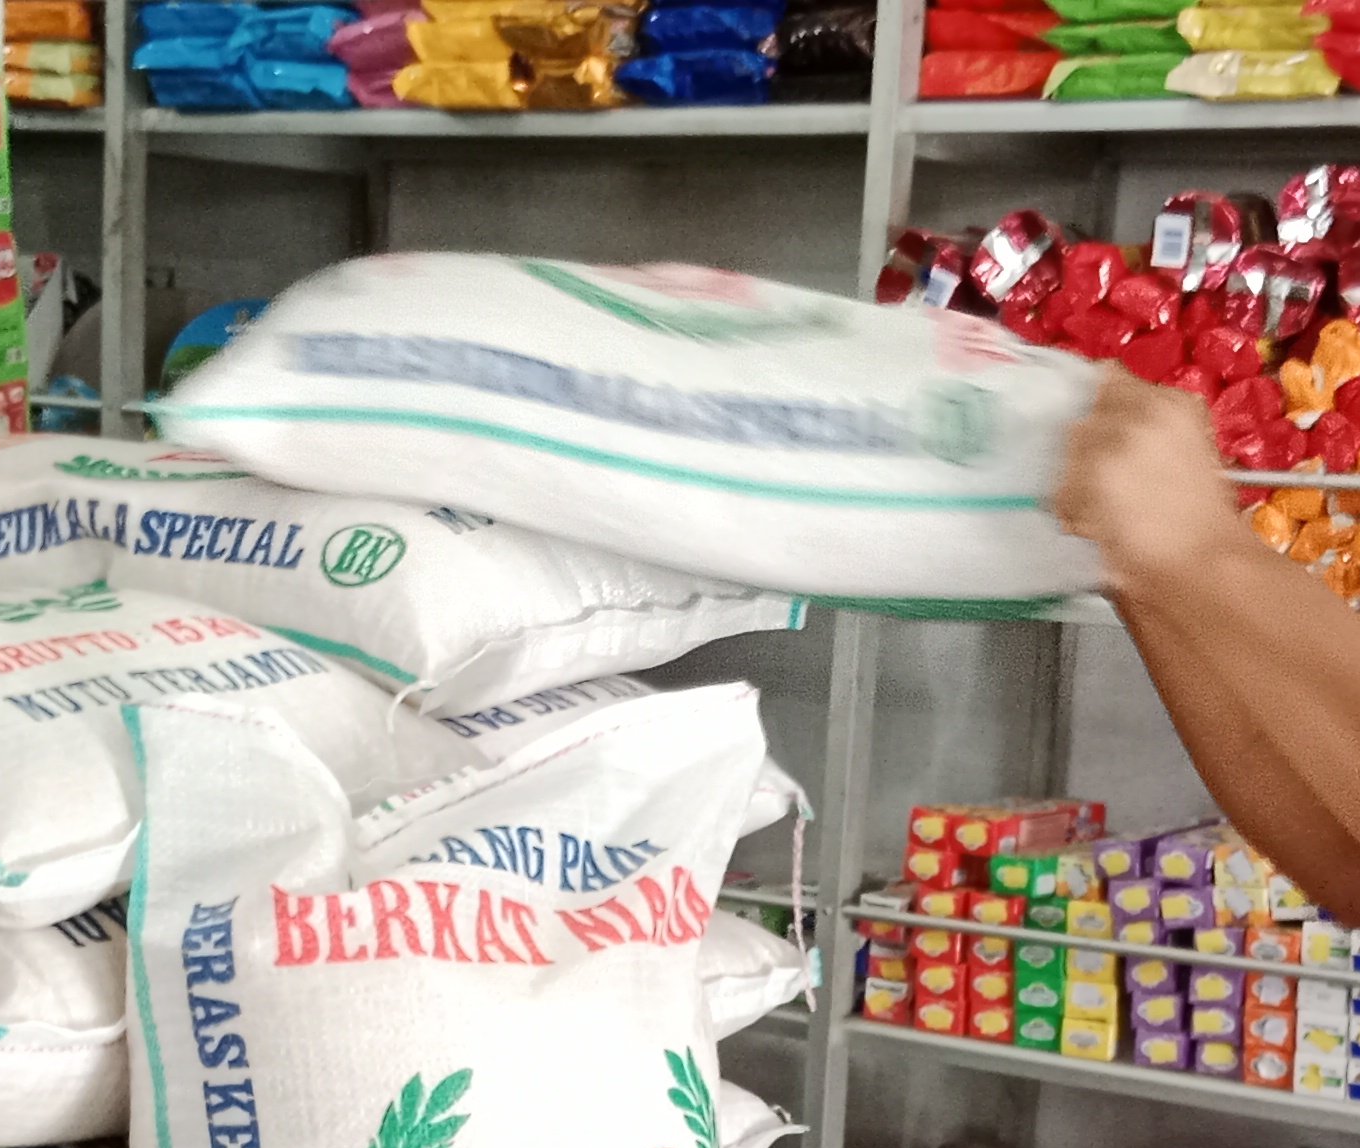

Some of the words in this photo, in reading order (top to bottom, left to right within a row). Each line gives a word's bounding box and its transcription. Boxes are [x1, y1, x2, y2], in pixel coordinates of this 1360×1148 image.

[134, 508, 305, 570] SPECIAL
[167, 616, 207, 649] 15
[2, 674, 130, 724] MUTU
[132, 645, 331, 703] TERJAMIN
[269, 878, 556, 968] BERKAT
[180, 893, 250, 1069] BERAS
